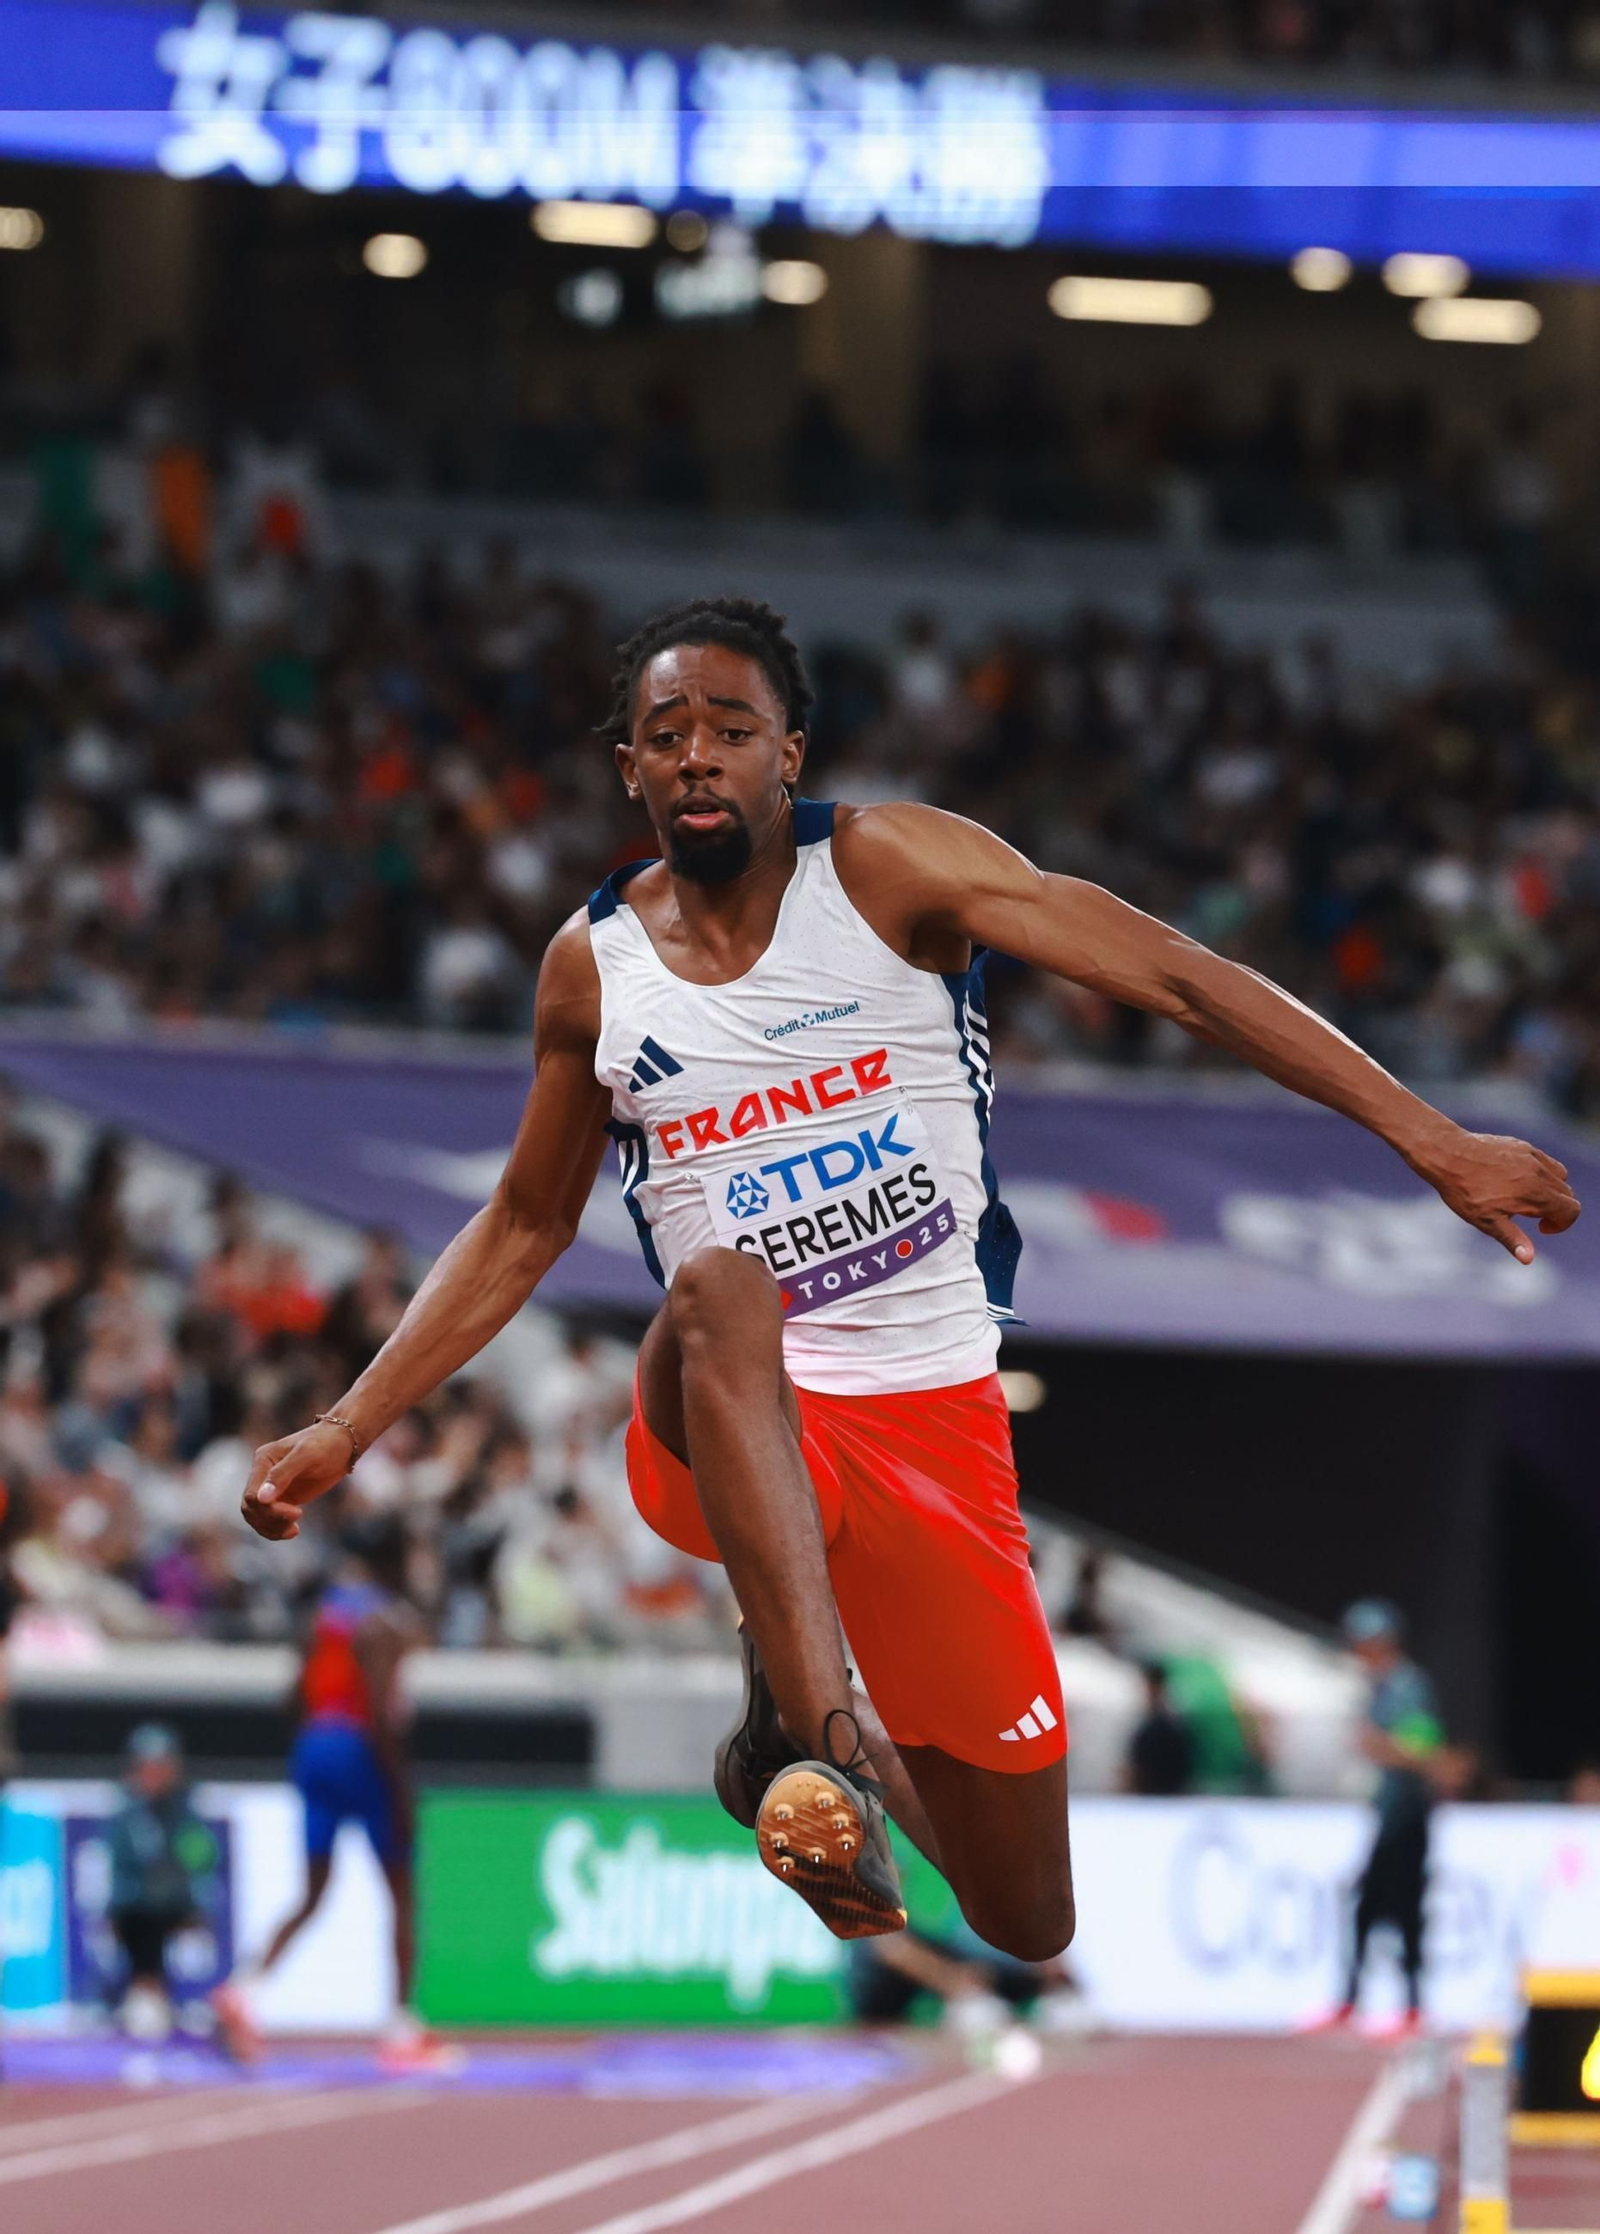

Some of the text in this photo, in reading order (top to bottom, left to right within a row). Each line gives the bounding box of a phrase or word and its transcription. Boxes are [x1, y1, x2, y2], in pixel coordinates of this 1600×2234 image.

[764, 1000, 860, 1041] Crédit Mutuel
[656, 1047, 892, 1160] FRANCE
[759, 1112, 916, 1203] TDK
[735, 1163, 936, 1273] SEREMES
